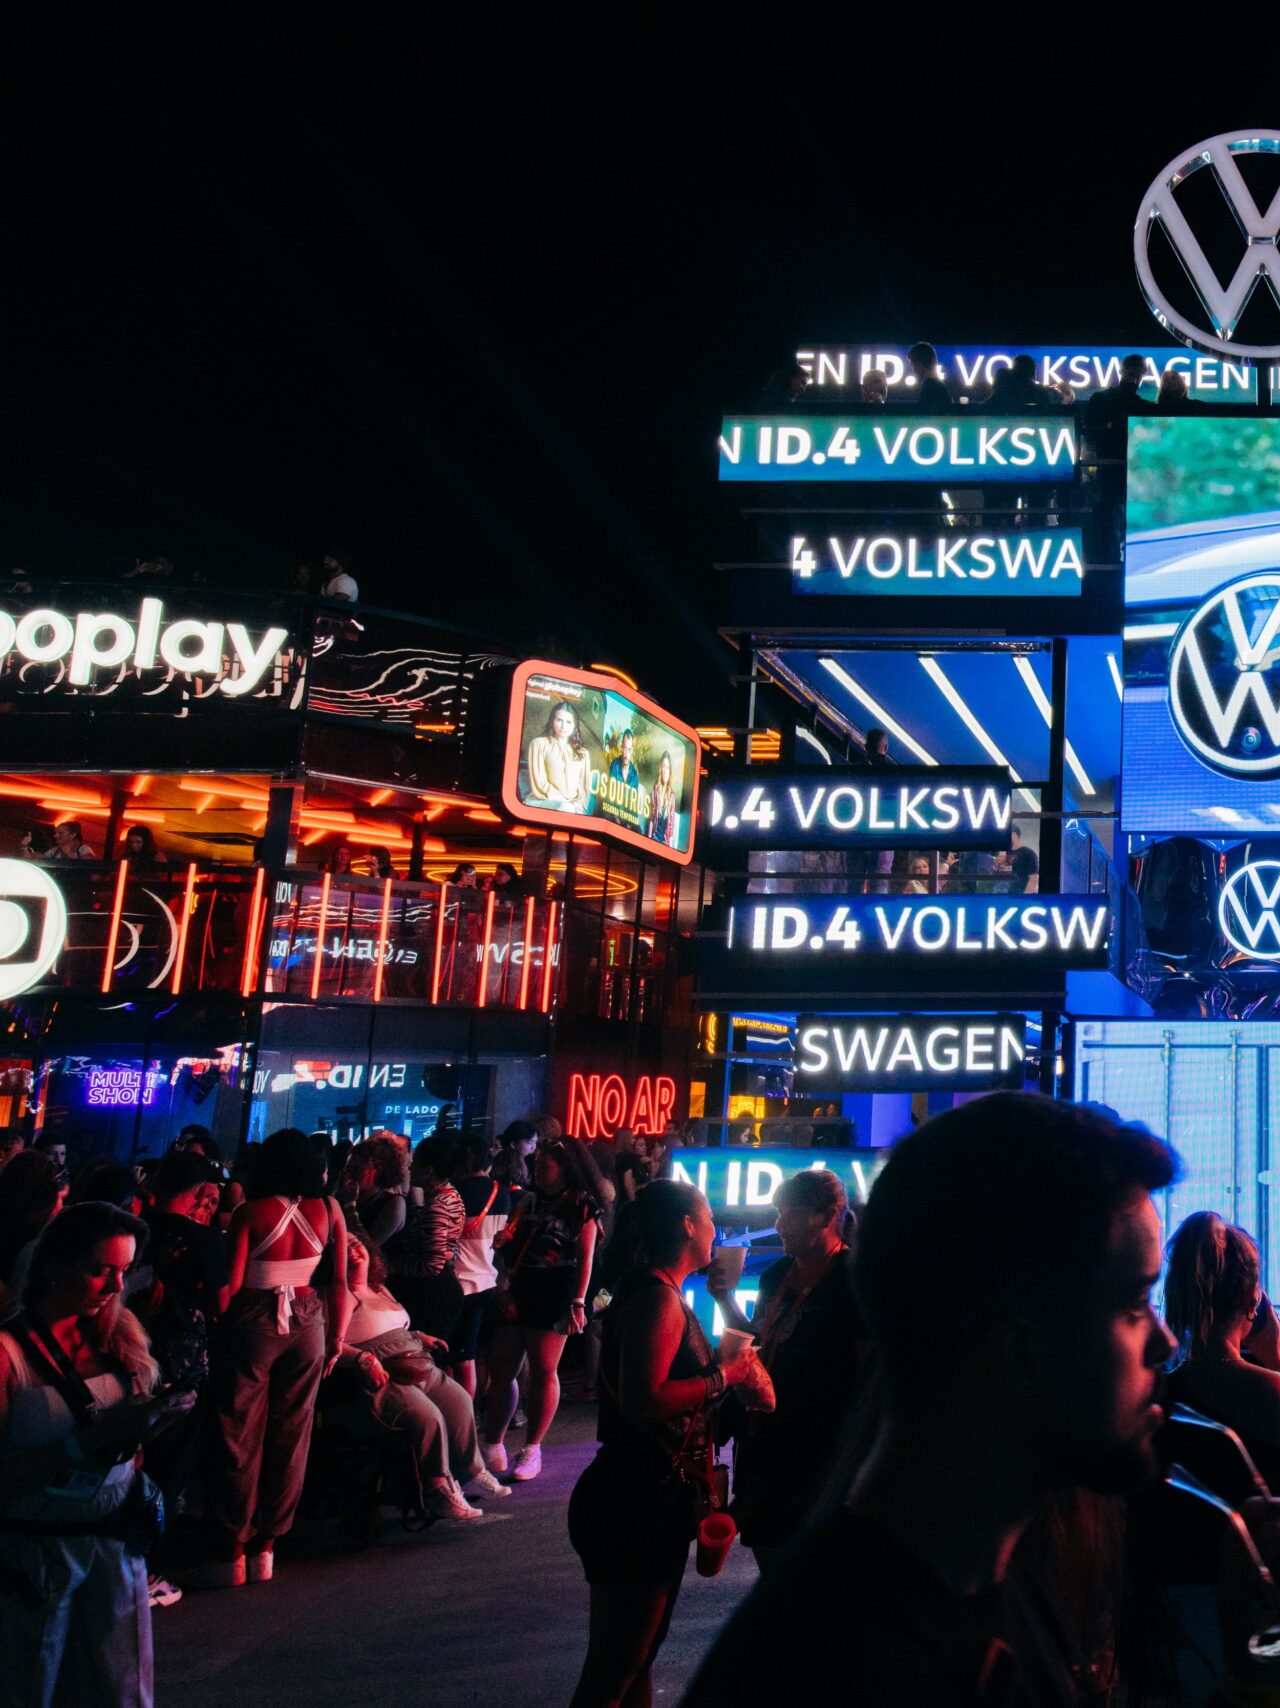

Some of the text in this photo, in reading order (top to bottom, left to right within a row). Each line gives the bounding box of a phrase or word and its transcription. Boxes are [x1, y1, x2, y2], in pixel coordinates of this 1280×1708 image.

[861, 353, 945, 386] ID.
[955, 354, 1249, 389] VOKSWAGEN
[758, 426, 861, 465] ID.4
[829, 537, 1084, 579] VOLKSWA
[589, 769, 652, 819] OS OUTROS
[752, 906, 1108, 950] ID.4 VOLKSW
[794, 1026, 1024, 1073] SWAGEN
[88, 1087, 153, 1105] SHOW
[90, 1071, 155, 1088] MULTI
[385, 1105, 439, 1114] DE LADO
[566, 1073, 676, 1139] NO AR
[725, 1161, 828, 1207] ID
